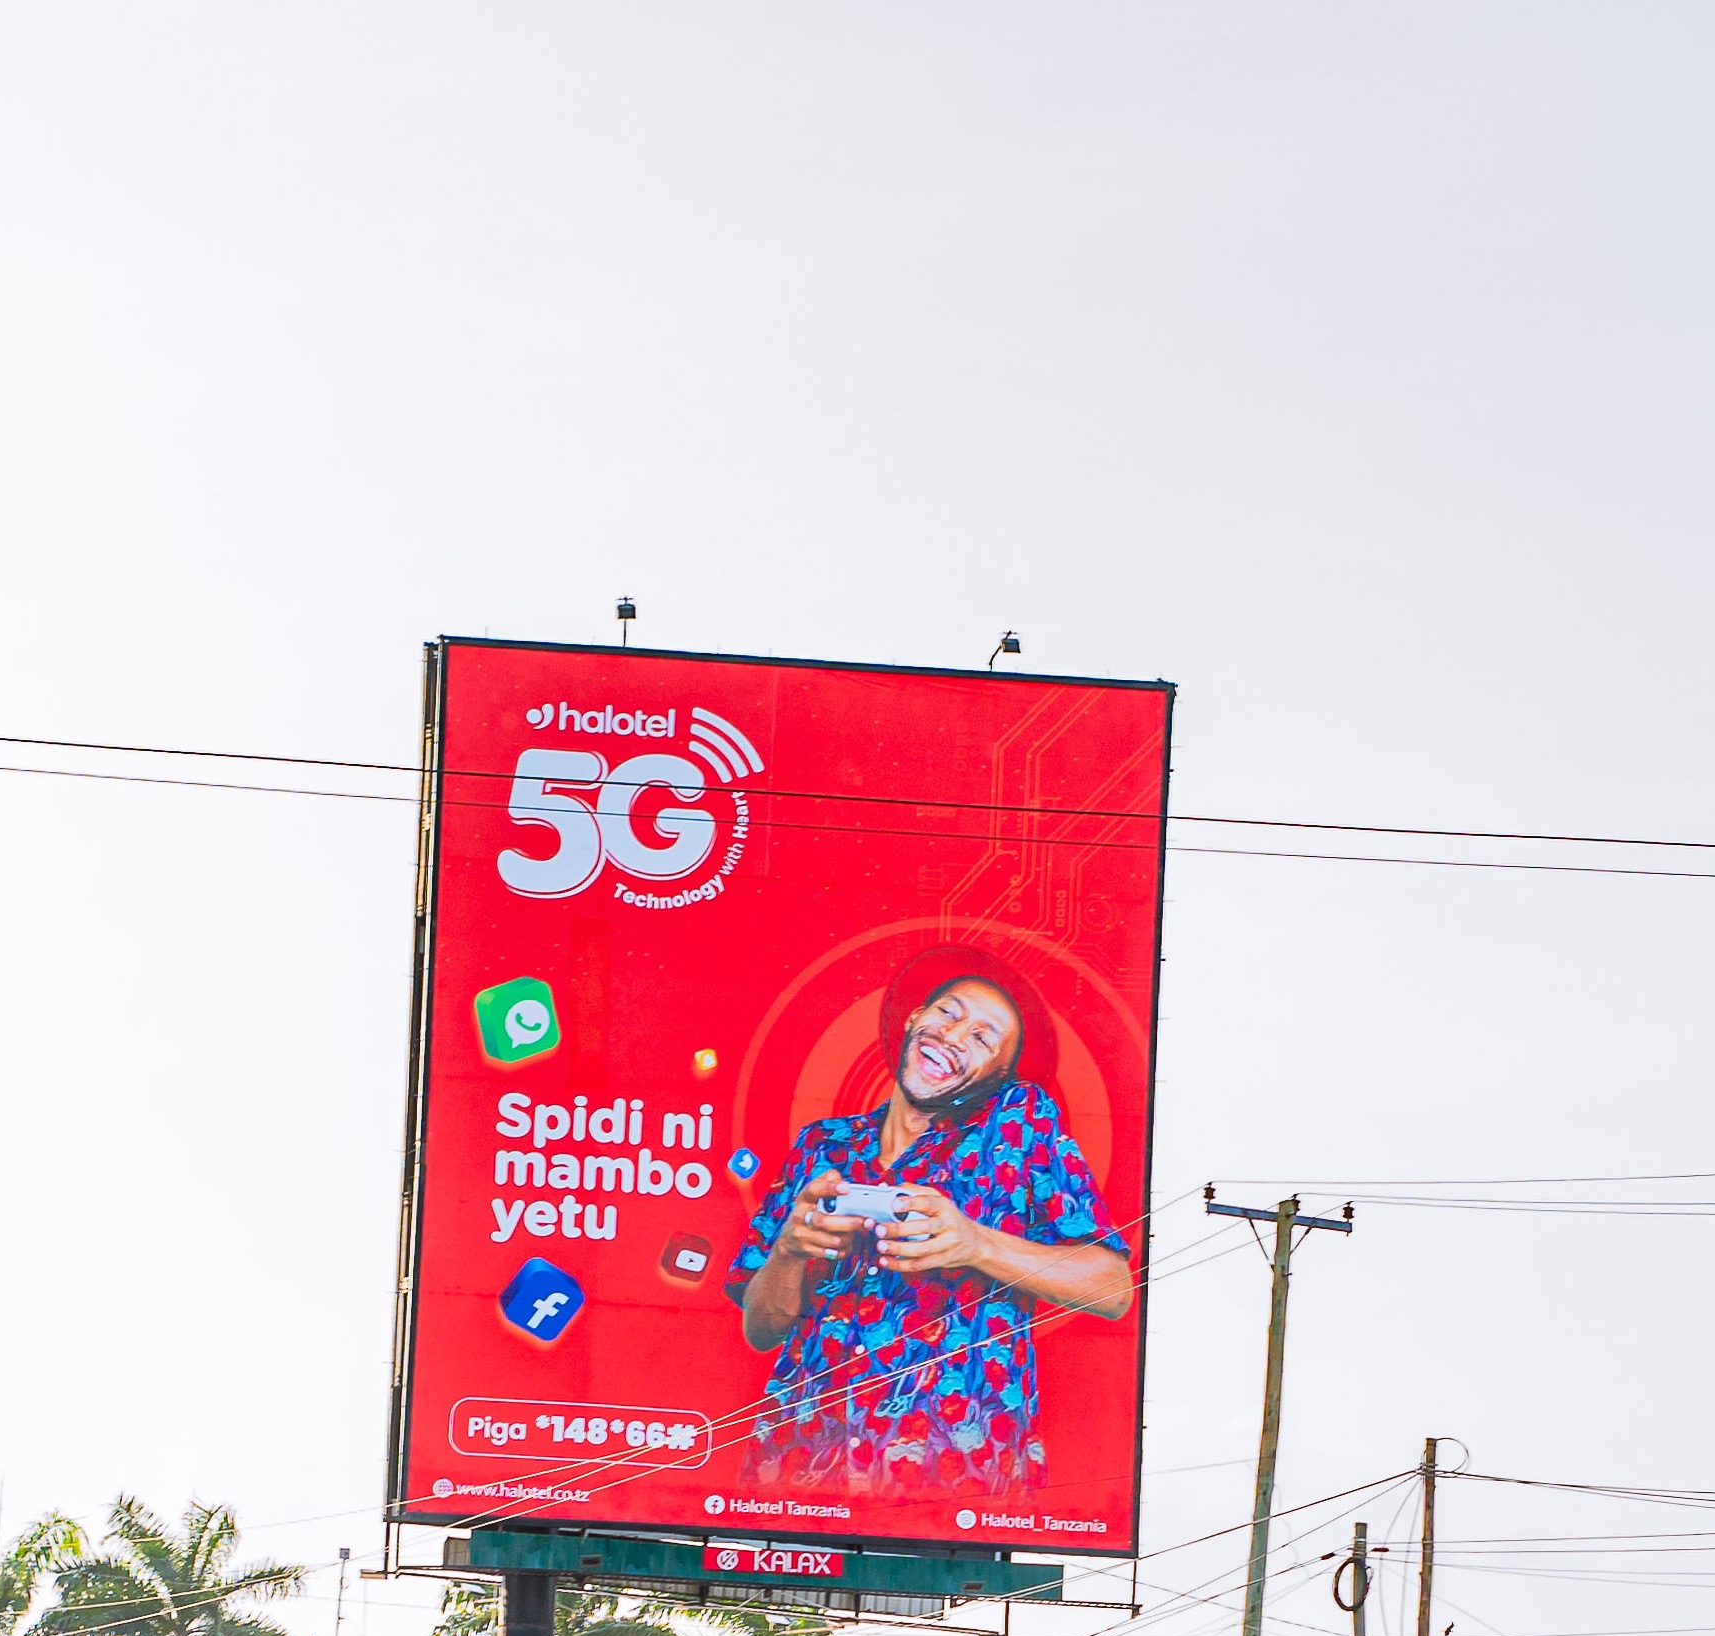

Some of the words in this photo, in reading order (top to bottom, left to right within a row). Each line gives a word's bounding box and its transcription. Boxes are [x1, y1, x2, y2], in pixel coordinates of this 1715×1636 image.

[558, 701, 677, 738] halotel
[496, 747, 718, 900] 5G
[730, 789, 750, 840] Heart
[718, 842, 746, 877] with
[613, 874, 725, 910] Technology
[495, 1092, 645, 1149] Spidi
[662, 1103, 714, 1150] ni
[493, 1147, 714, 1199] mambo
[490, 1194, 618, 1243] yetu
[467, 1415, 527, 1446] Piga
[456, 1483, 589, 1502] www.halotel.co.tz
[729, 1498, 784, 1515] Halotel
[785, 1500, 851, 1519] Tanzania
[980, 1512, 1107, 1534] Halotel_Tanzania
[753, 1550, 832, 1575] KALAX
